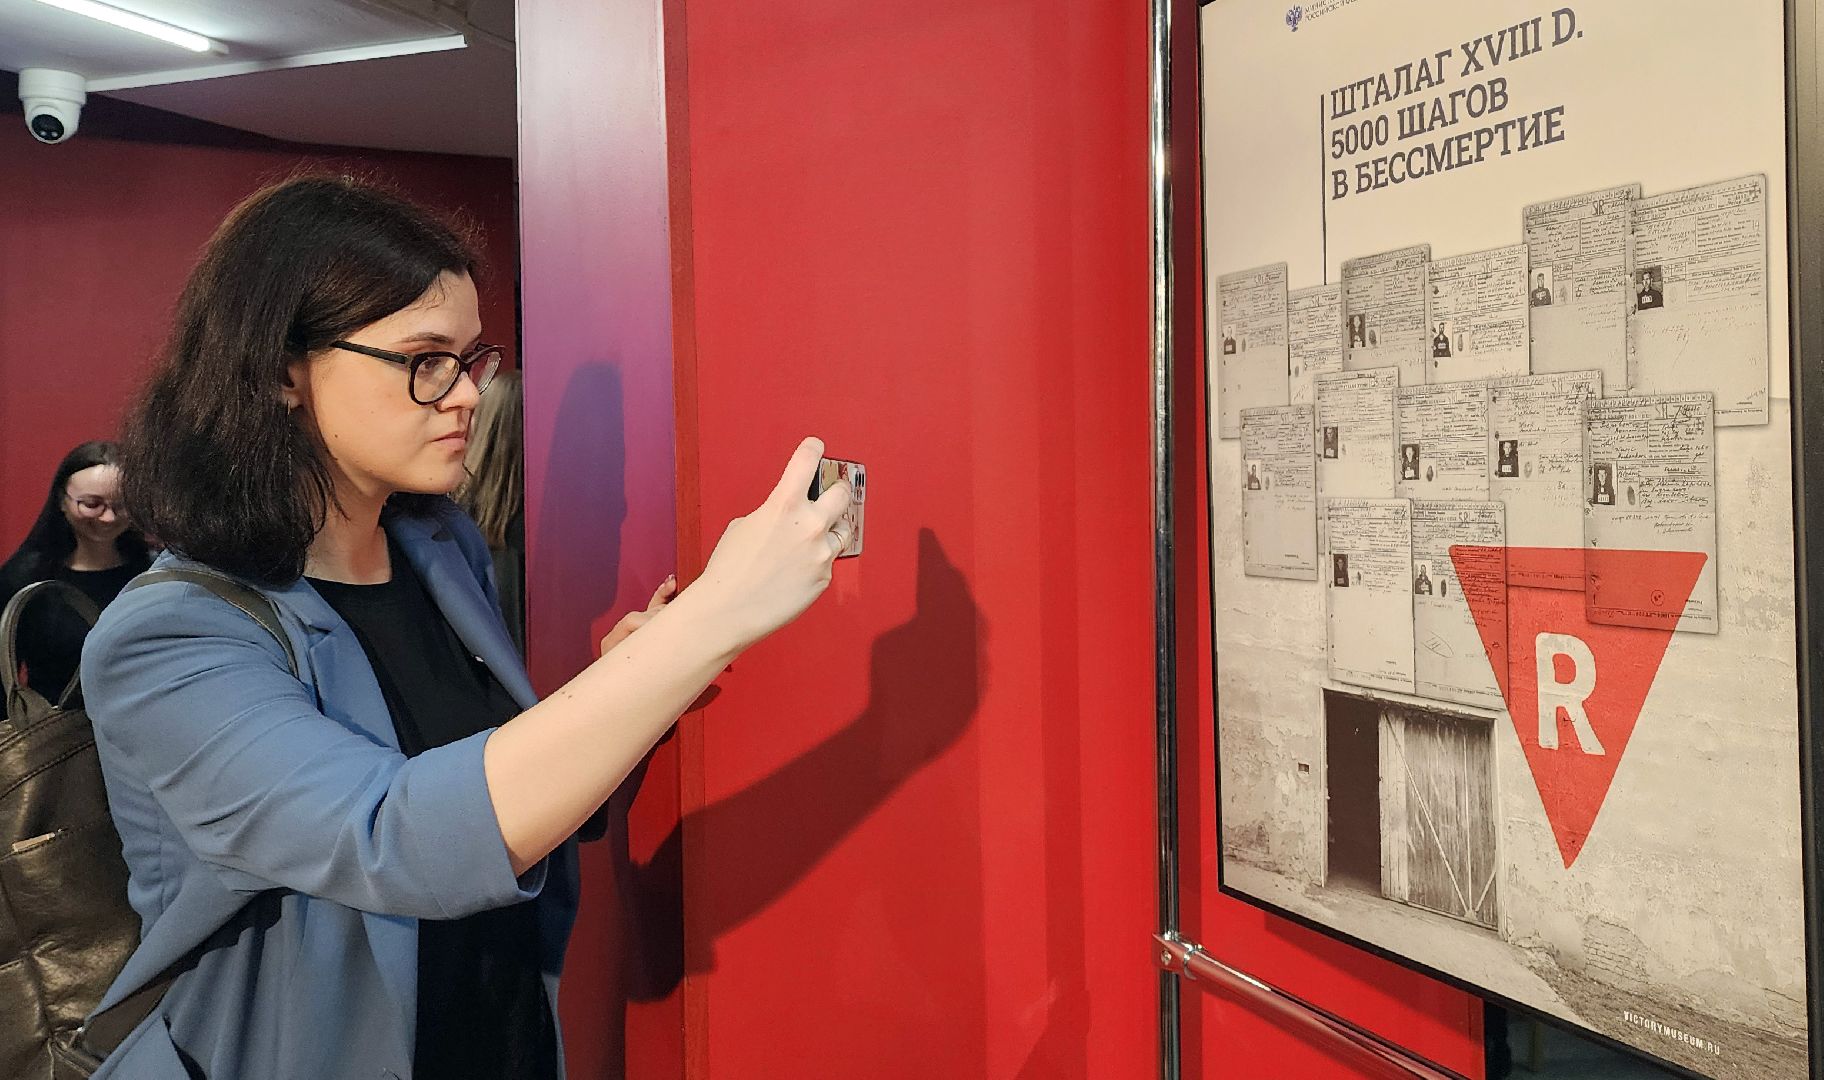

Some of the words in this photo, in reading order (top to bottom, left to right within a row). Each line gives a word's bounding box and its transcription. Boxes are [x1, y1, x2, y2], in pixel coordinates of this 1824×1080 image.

[1331, 49, 1453, 120] ШТАЛАГ
[1461, 17, 1543, 77] XVIII
[1552, 8, 1583, 47] D.
[1332, 115, 1389, 159] 5000
[1397, 78, 1508, 140] ШАГОВ
[1332, 169, 1349, 200] В
[1355, 105, 1565, 194] БЕССМЕРТИЕ
[1535, 632, 1606, 756] R
[1624, 1011, 1720, 1055] VICTORYMUSEUM.RU
